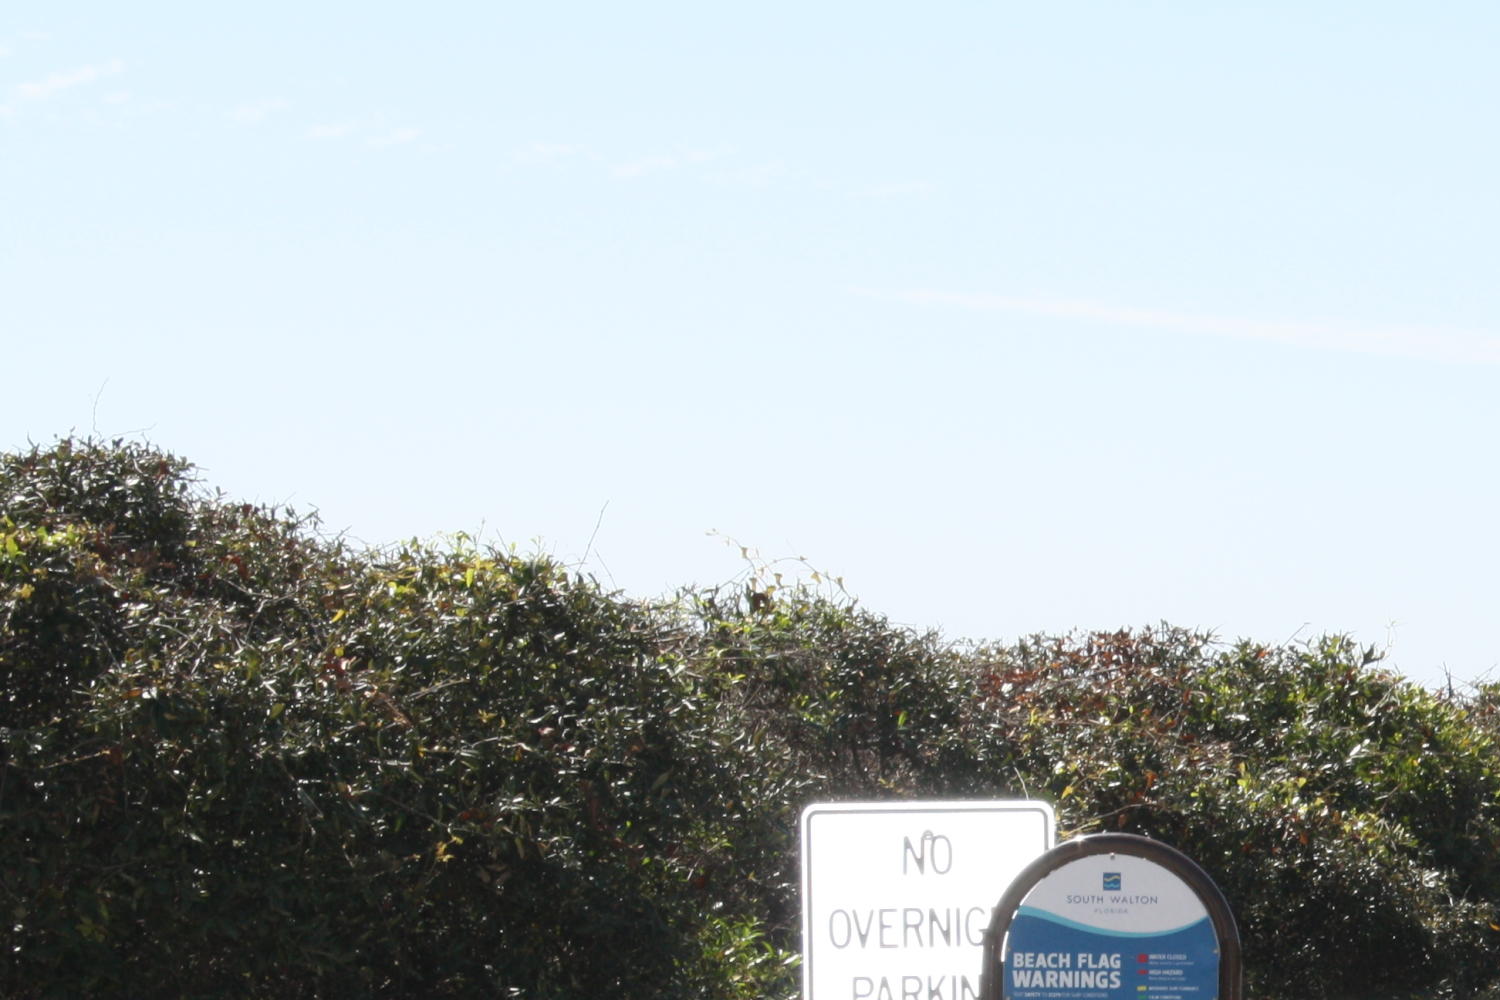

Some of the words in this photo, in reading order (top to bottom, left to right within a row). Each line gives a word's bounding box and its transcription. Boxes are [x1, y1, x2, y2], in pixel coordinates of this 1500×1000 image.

[903, 834, 952, 875] NO
[1066, 894, 1104, 905] SOUTH
[1110, 895, 1158, 905] WALTON
[829, 907, 986, 949] OVERNIG
[1013, 952, 1071, 969] BEACH
[1077, 953, 1121, 969] FLAG
[1012, 970, 1121, 989] WARNINGS
